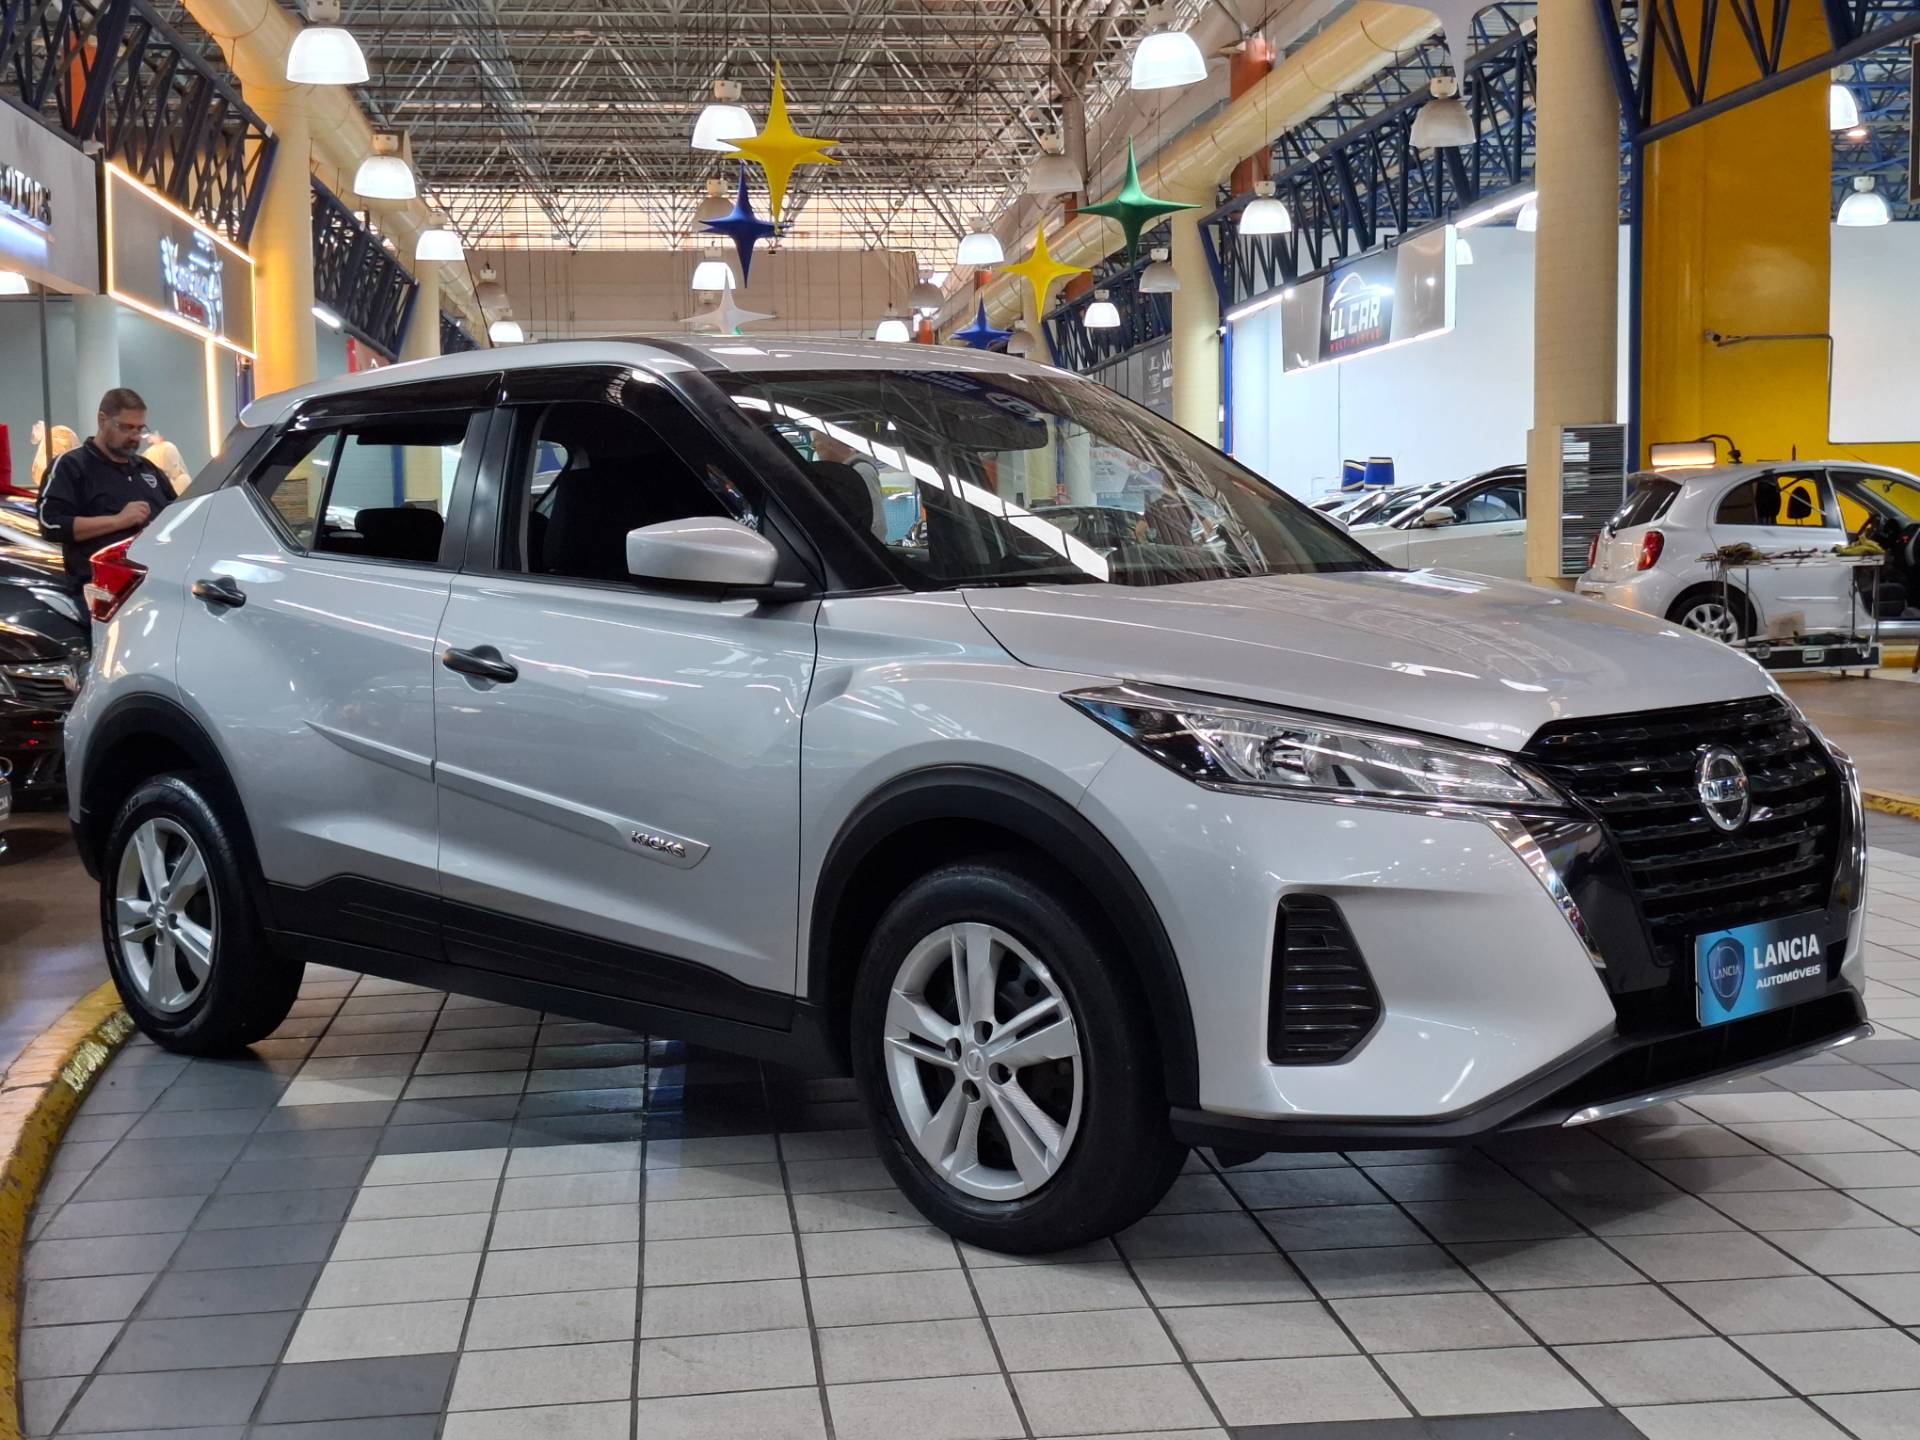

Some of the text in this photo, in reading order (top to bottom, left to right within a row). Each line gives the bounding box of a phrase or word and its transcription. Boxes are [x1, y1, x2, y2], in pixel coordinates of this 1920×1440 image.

[0, 163, 51, 225] OTORS
[1348, 296, 1380, 334] CAR
[1753, 933, 1820, 970] LANCIA
[1713, 964, 1741, 980] LANCIA
[1755, 964, 1821, 990] AUTOMÓVEIS
